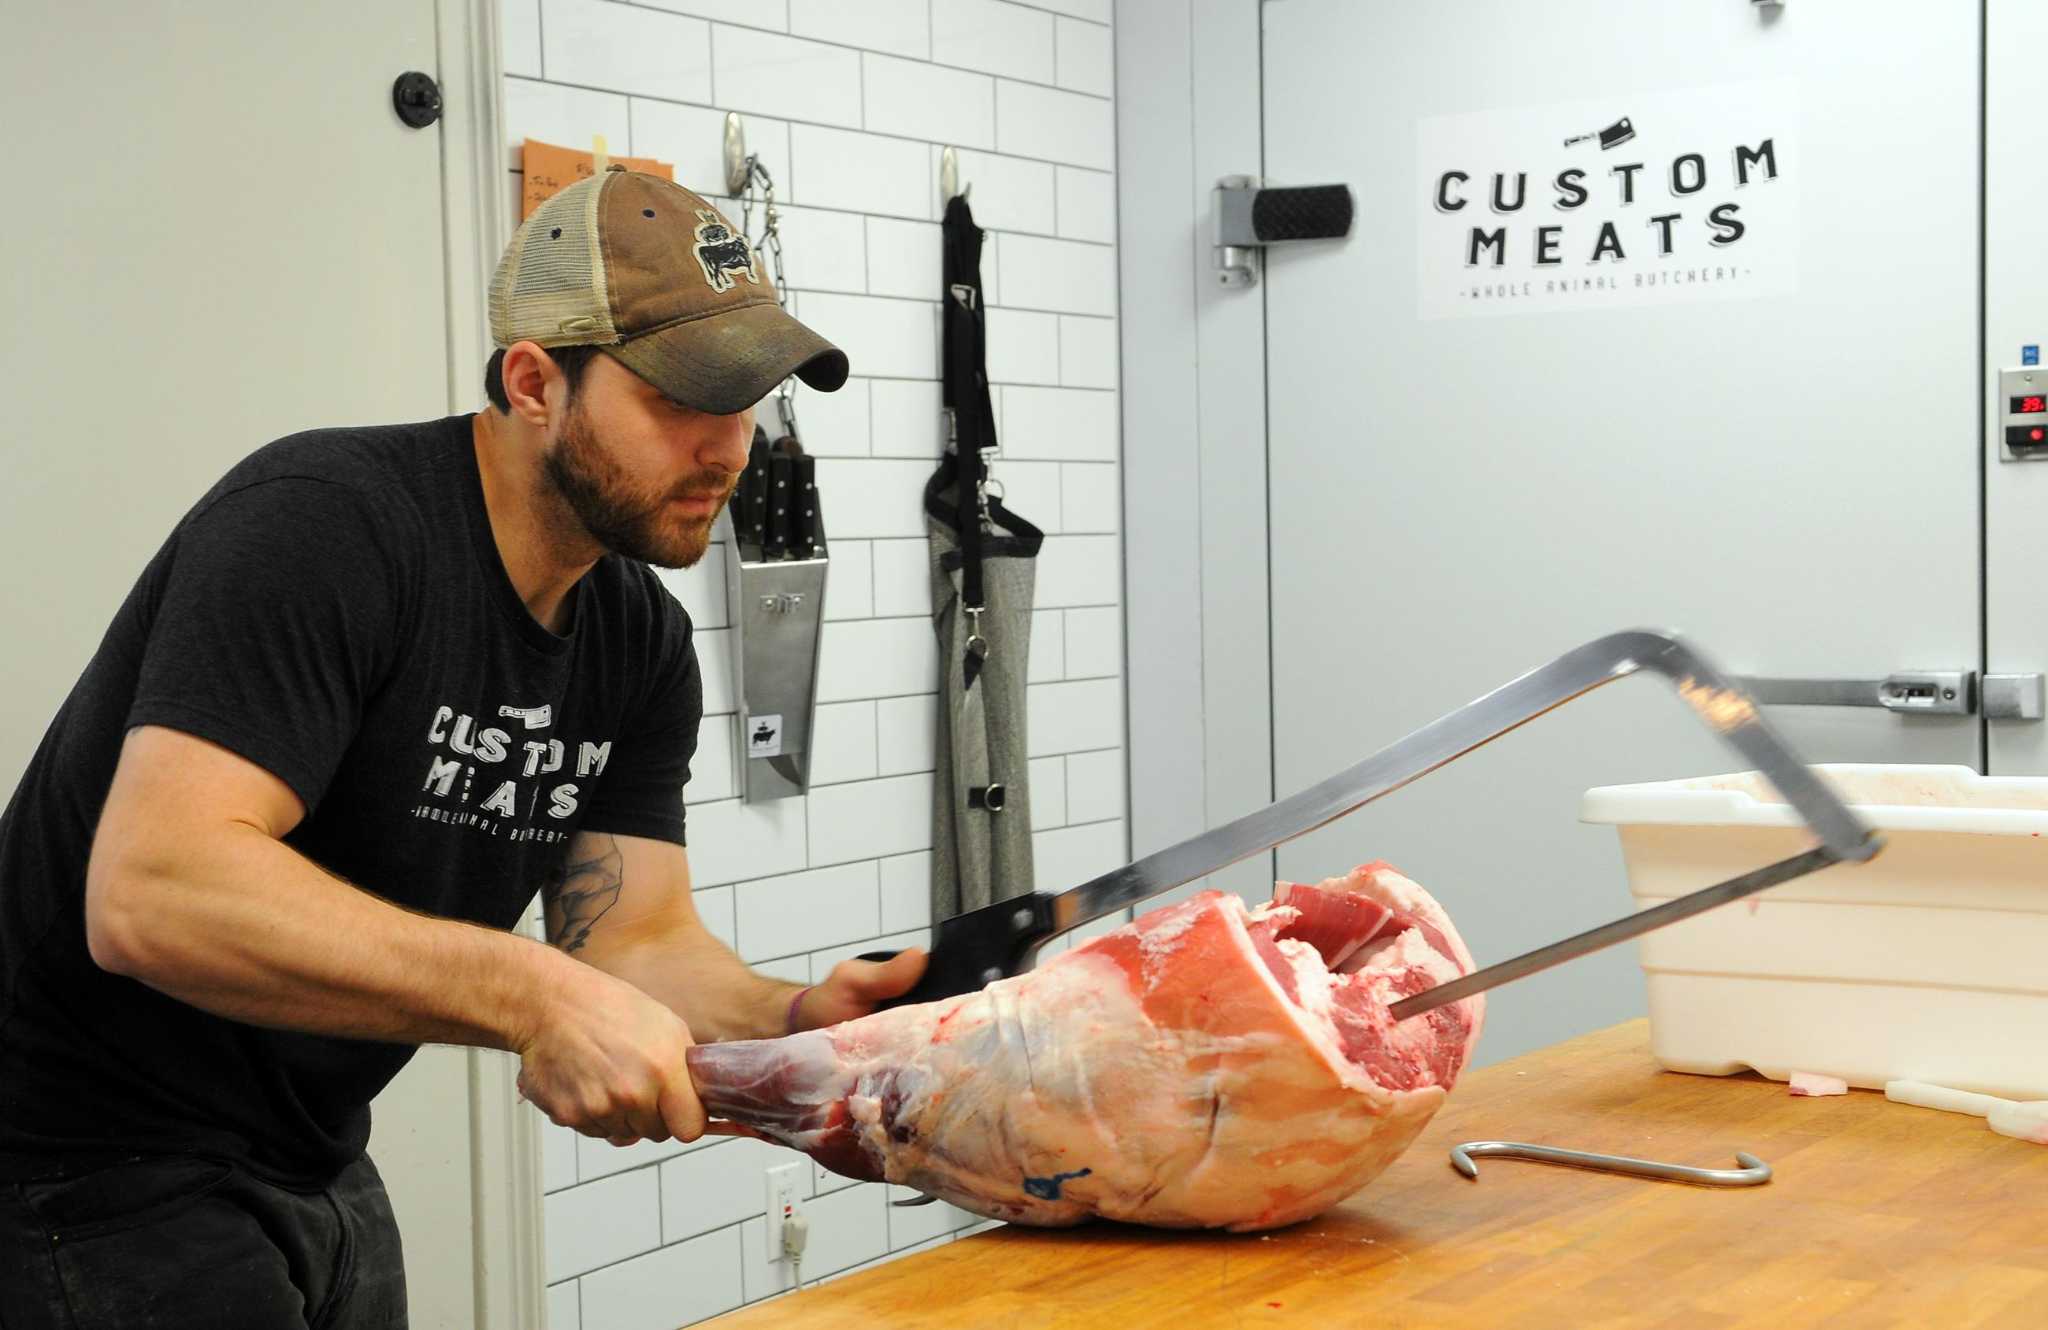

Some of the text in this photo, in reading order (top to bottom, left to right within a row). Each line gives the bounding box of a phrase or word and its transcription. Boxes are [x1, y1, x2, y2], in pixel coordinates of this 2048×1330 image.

[1434, 138, 1778, 213] CUSTOM
[1465, 203, 1746, 268] MEATS
[1546, 276, 1618, 294] ANIMAL
[427, 705, 612, 778] CUSTOM
[421, 755, 580, 819] MAS
